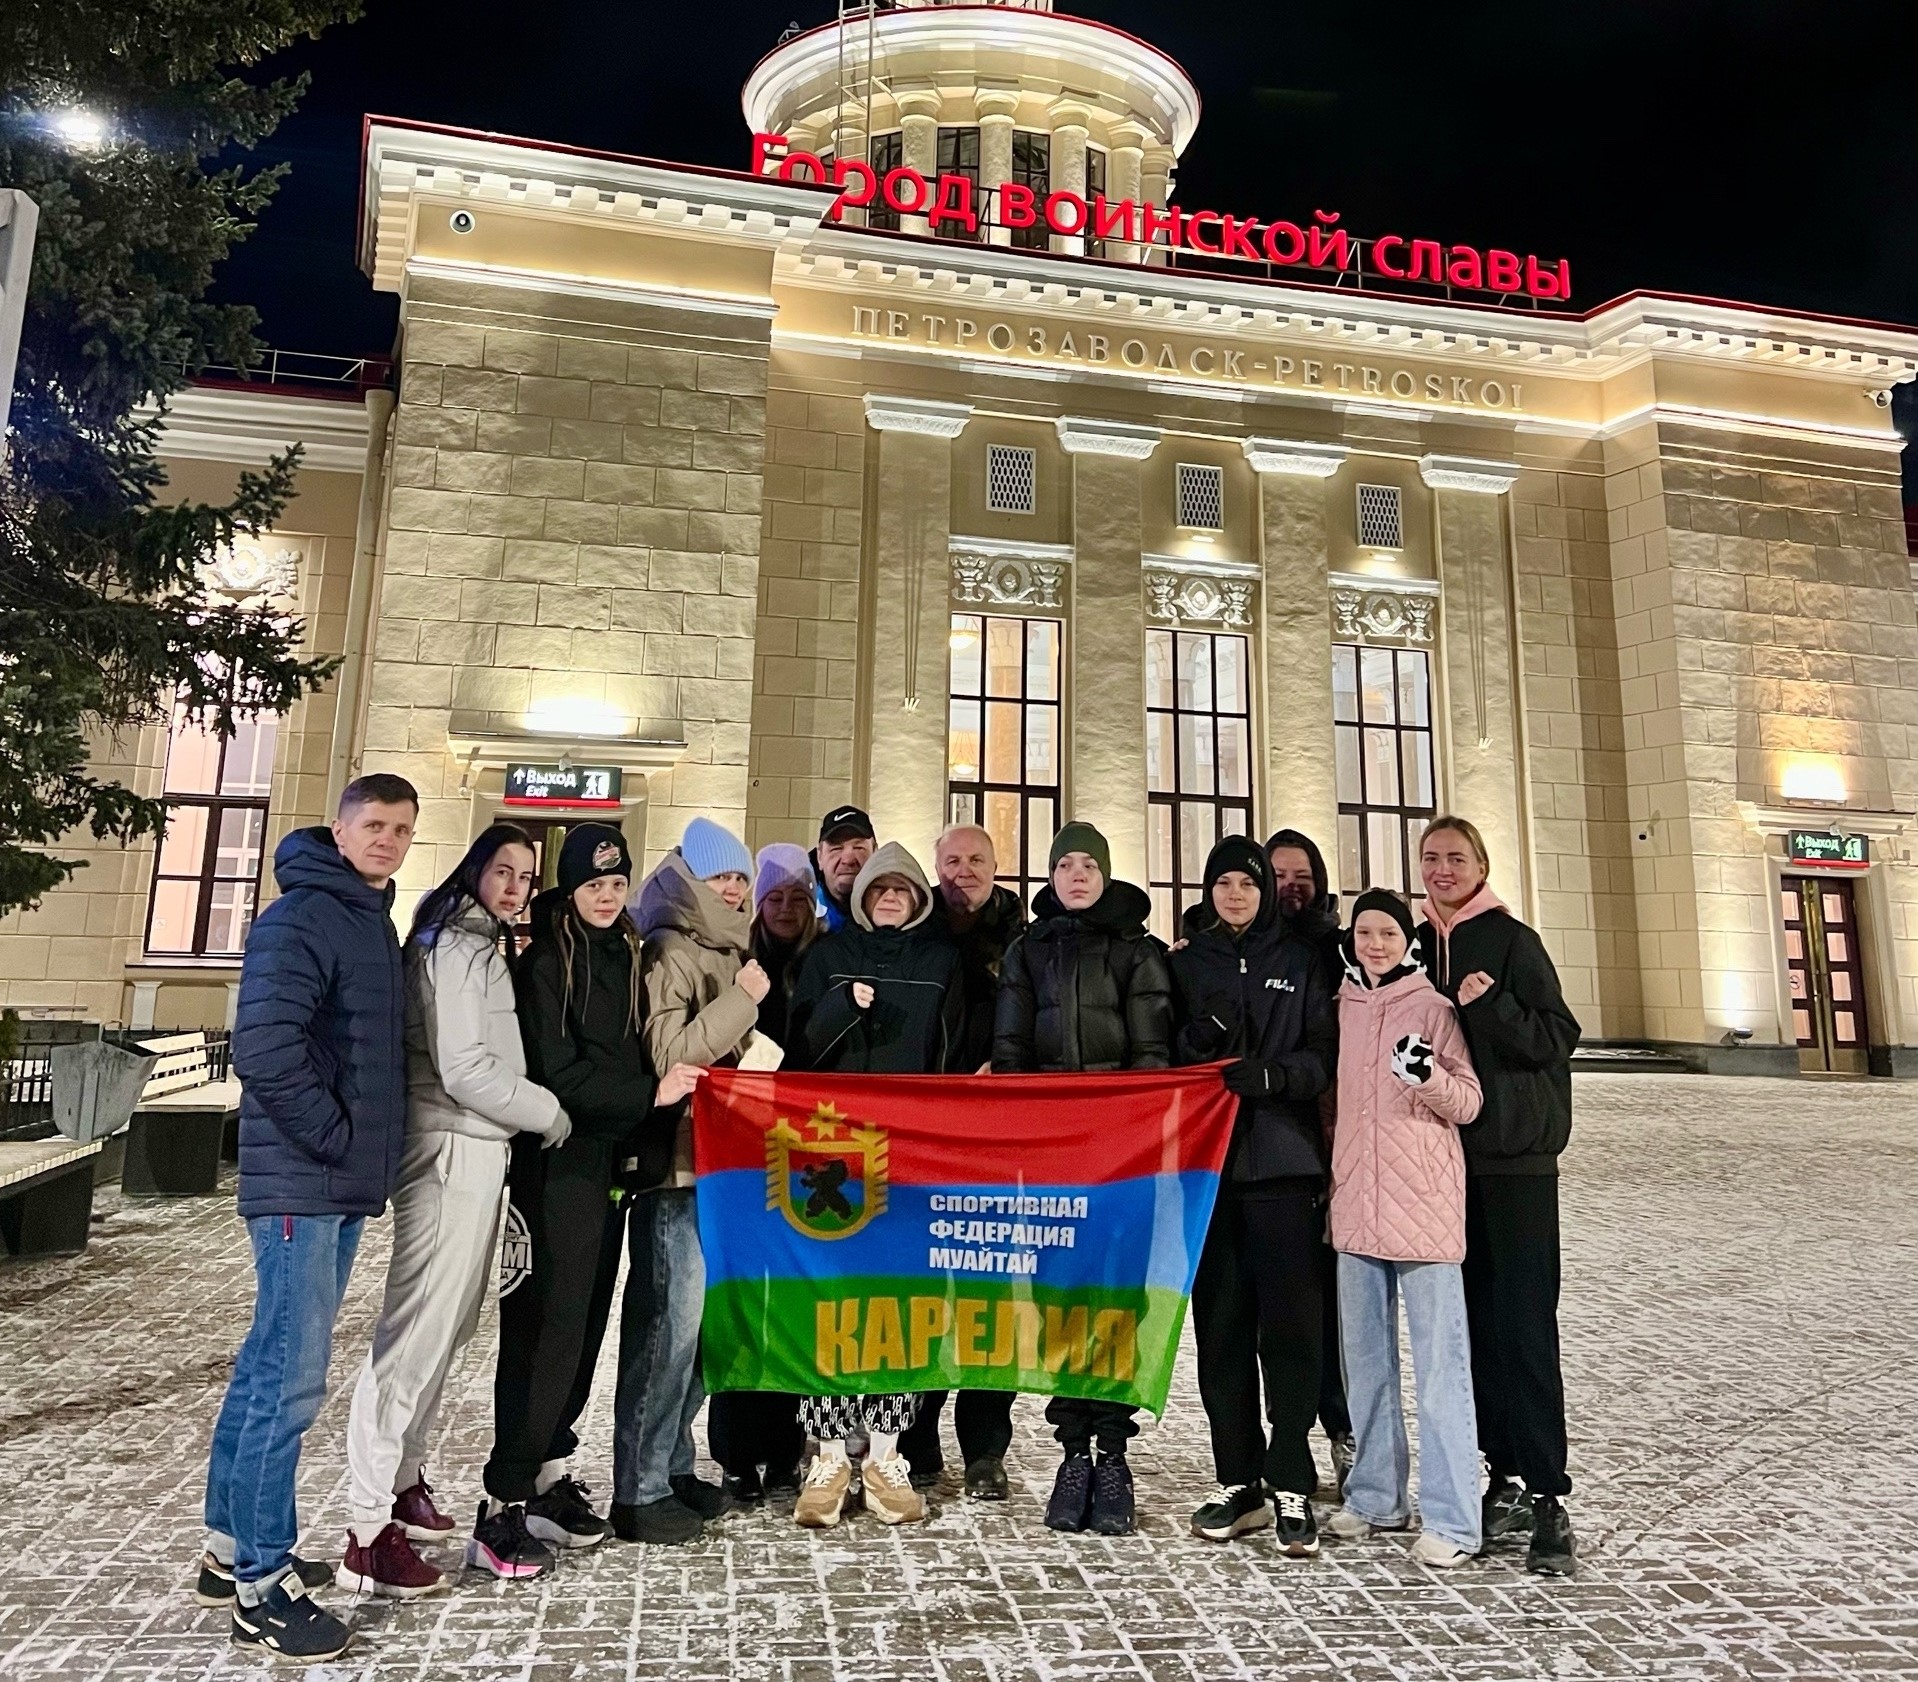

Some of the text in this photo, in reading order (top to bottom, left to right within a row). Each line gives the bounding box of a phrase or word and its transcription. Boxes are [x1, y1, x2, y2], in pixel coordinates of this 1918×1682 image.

[753, 132, 1571, 300] Город воинской славы
[526, 768, 577, 788] Выход
[930, 1194, 1088, 1218] СПОРТИВНАЯ
[929, 1219, 1075, 1249] ФЕДЕРАЦИЯ
[929, 1246, 1037, 1274] МУАЙТАЙ
[816, 1296, 1136, 1381] КАРЕЛИЯ
